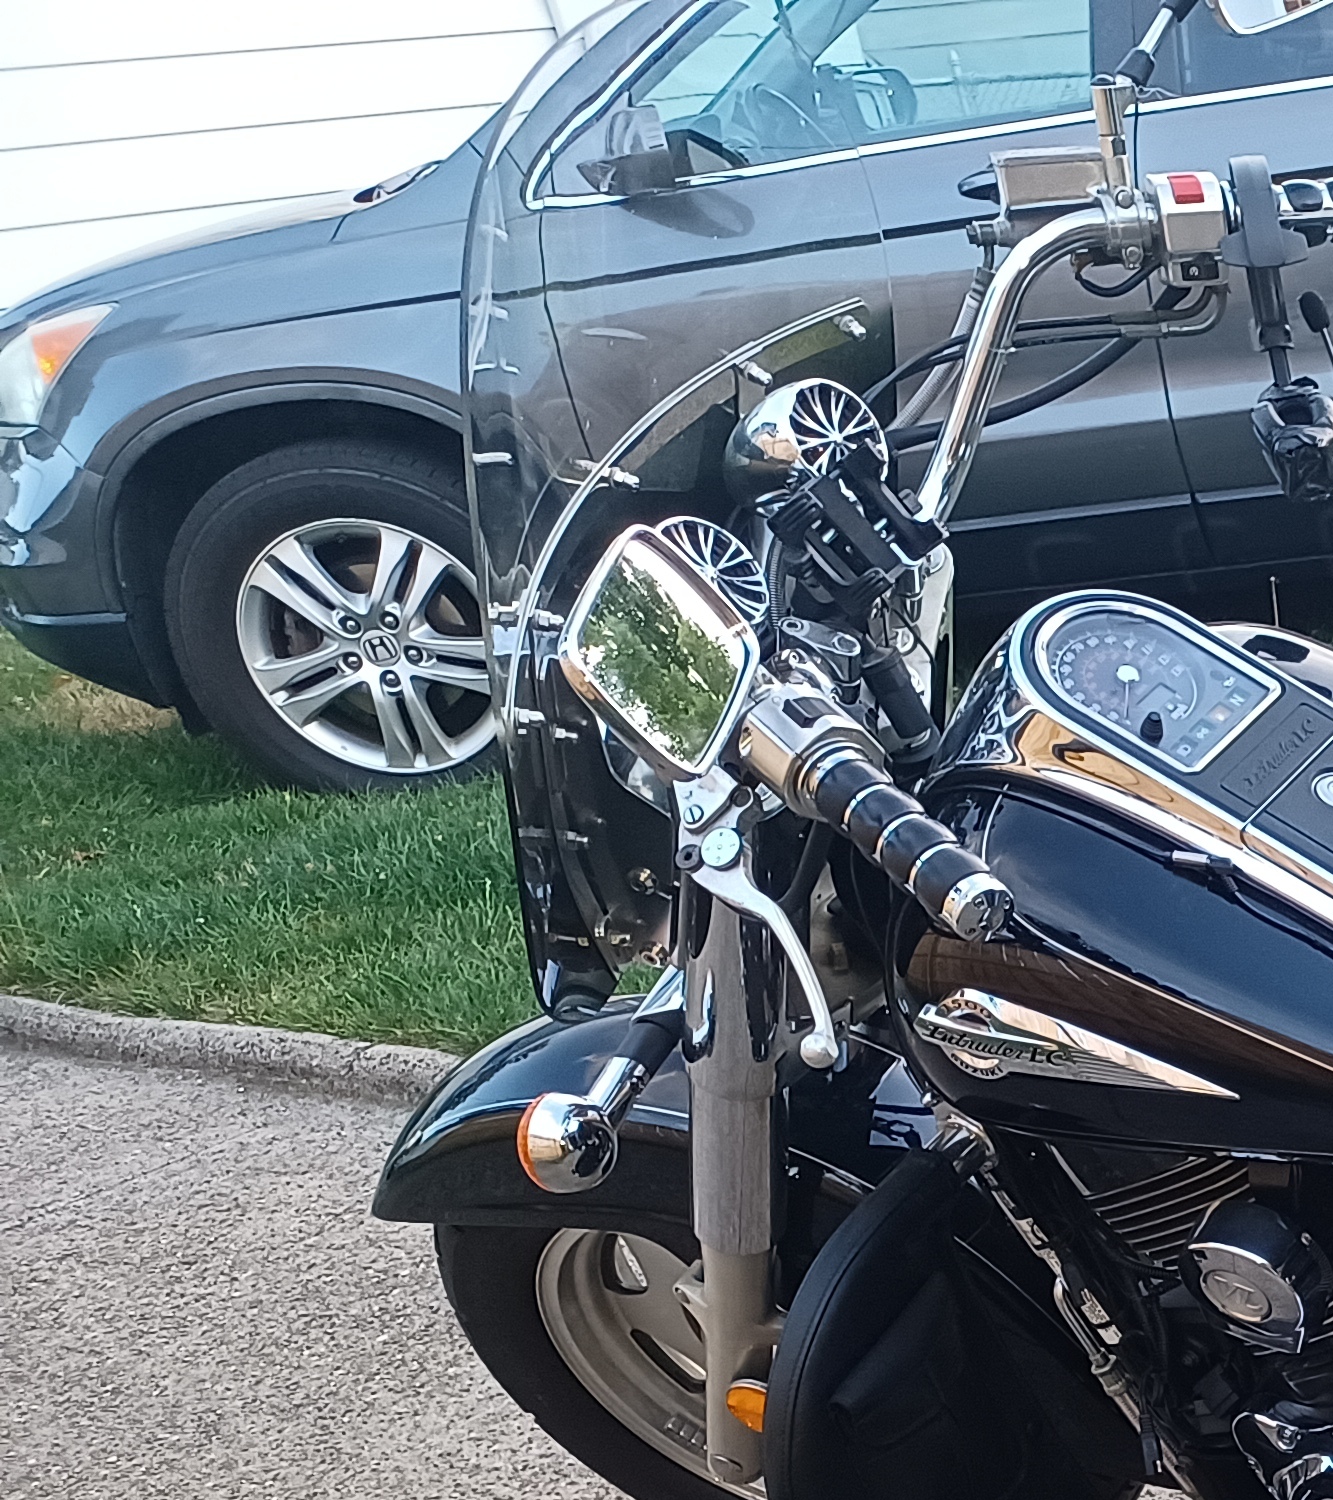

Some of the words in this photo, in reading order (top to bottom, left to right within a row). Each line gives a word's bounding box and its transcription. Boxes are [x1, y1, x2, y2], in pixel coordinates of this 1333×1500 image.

[940, 999, 992, 1020] 1500
[922, 1024, 1024, 1061] Intruder
[1028, 1047, 1069, 1068] LC
